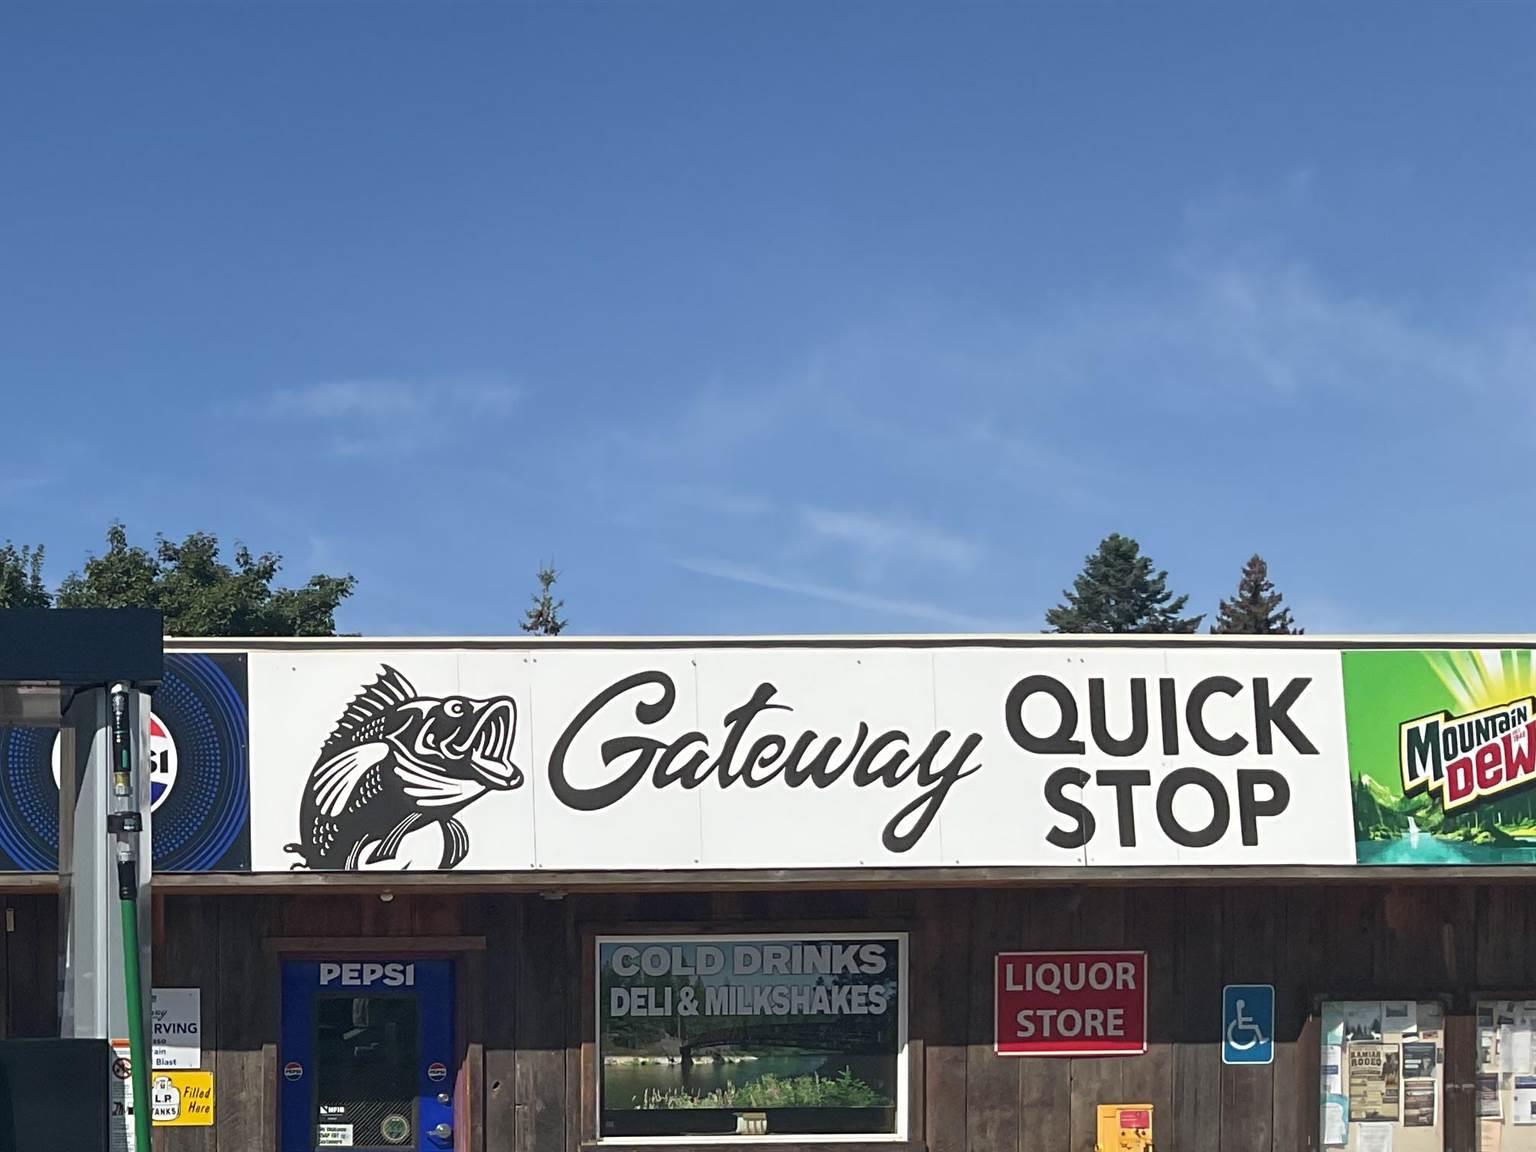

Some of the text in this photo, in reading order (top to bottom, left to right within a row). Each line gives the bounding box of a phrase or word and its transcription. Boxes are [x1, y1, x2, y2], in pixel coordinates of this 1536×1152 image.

[1005, 674, 1320, 757] QUICK
[548, 669, 982, 853] Gateway
[1045, 766, 1291, 849] STOP
[319, 963, 415, 986] PEPSI
[612, 944, 887, 977] COLD DRINKS
[1005, 961, 1137, 994] LIQUOR
[610, 984, 888, 1017] DELI & MILKSHAKES
[154, 1022, 198, 1034] RVING
[1016, 1008, 1126, 1038] STORE
[156, 1058, 177, 1066] Blast
[183, 1086, 211, 1099] Filled
[188, 1101, 211, 1113] Here
